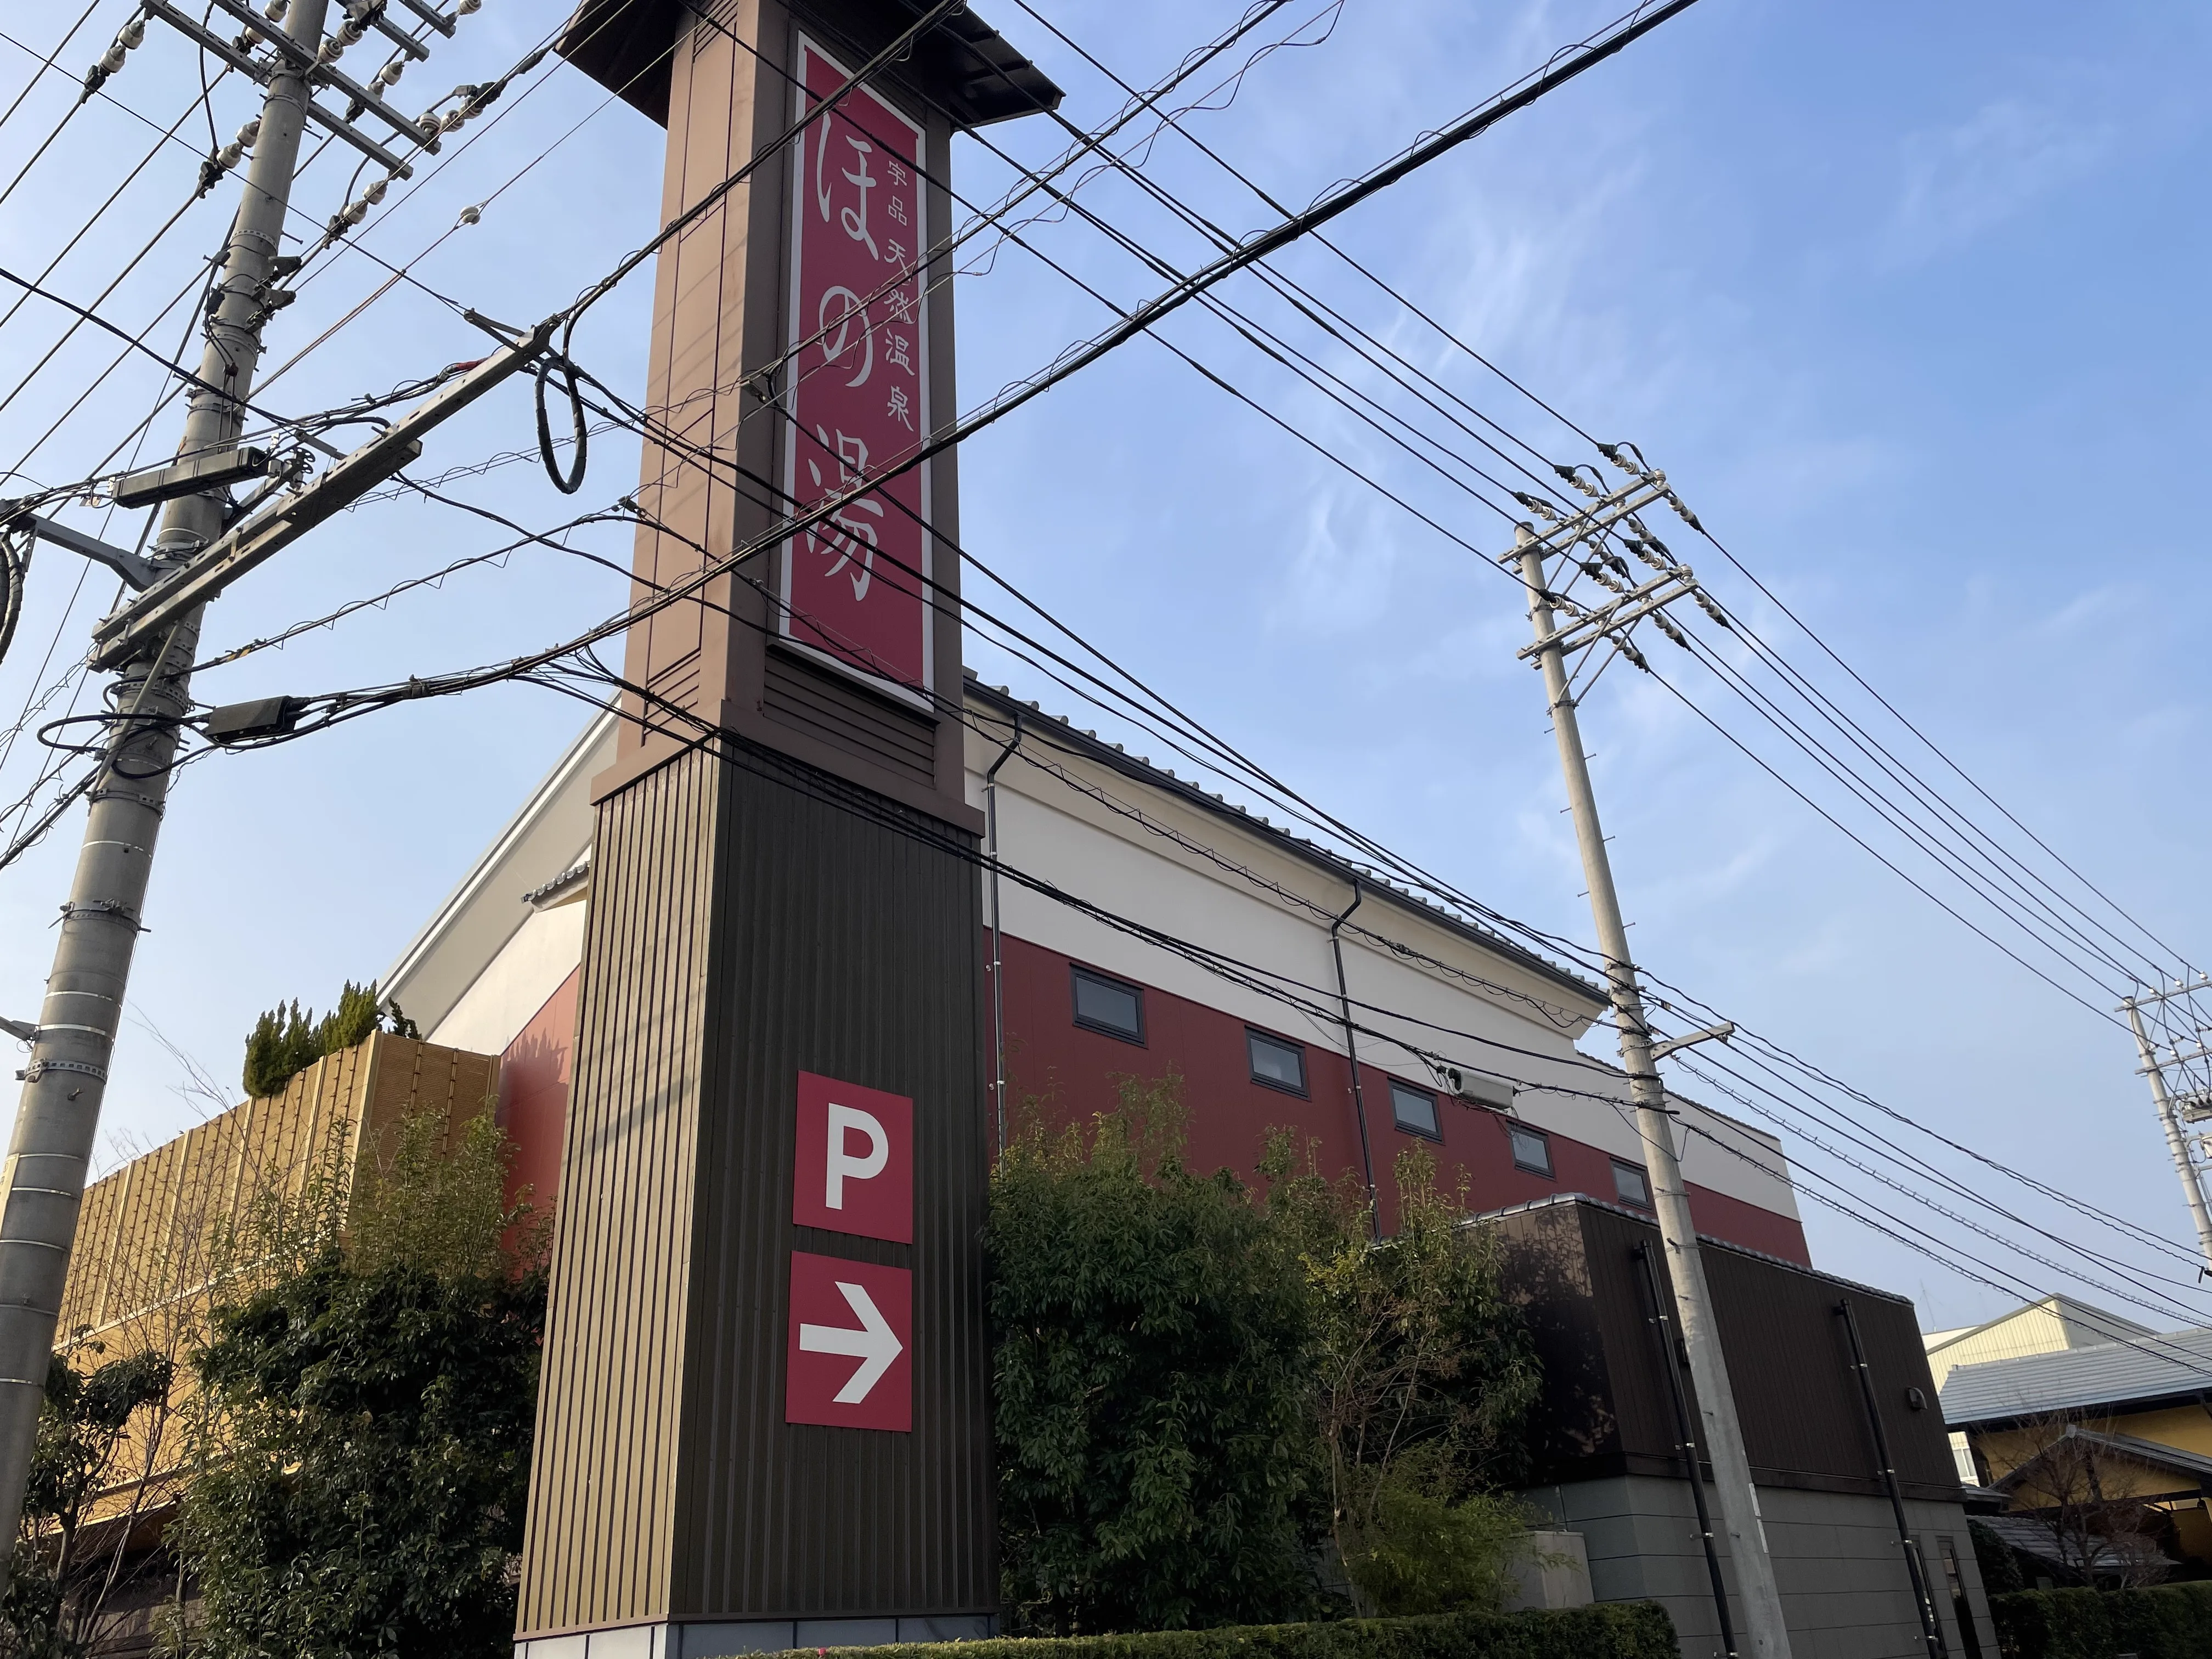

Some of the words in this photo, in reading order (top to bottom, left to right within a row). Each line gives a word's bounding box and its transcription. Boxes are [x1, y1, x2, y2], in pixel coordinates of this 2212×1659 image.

[808, 111, 883, 601] ほの湯
[884, 160, 915, 431] 宇品天然温泉
[826, 1102, 889, 1210] P
